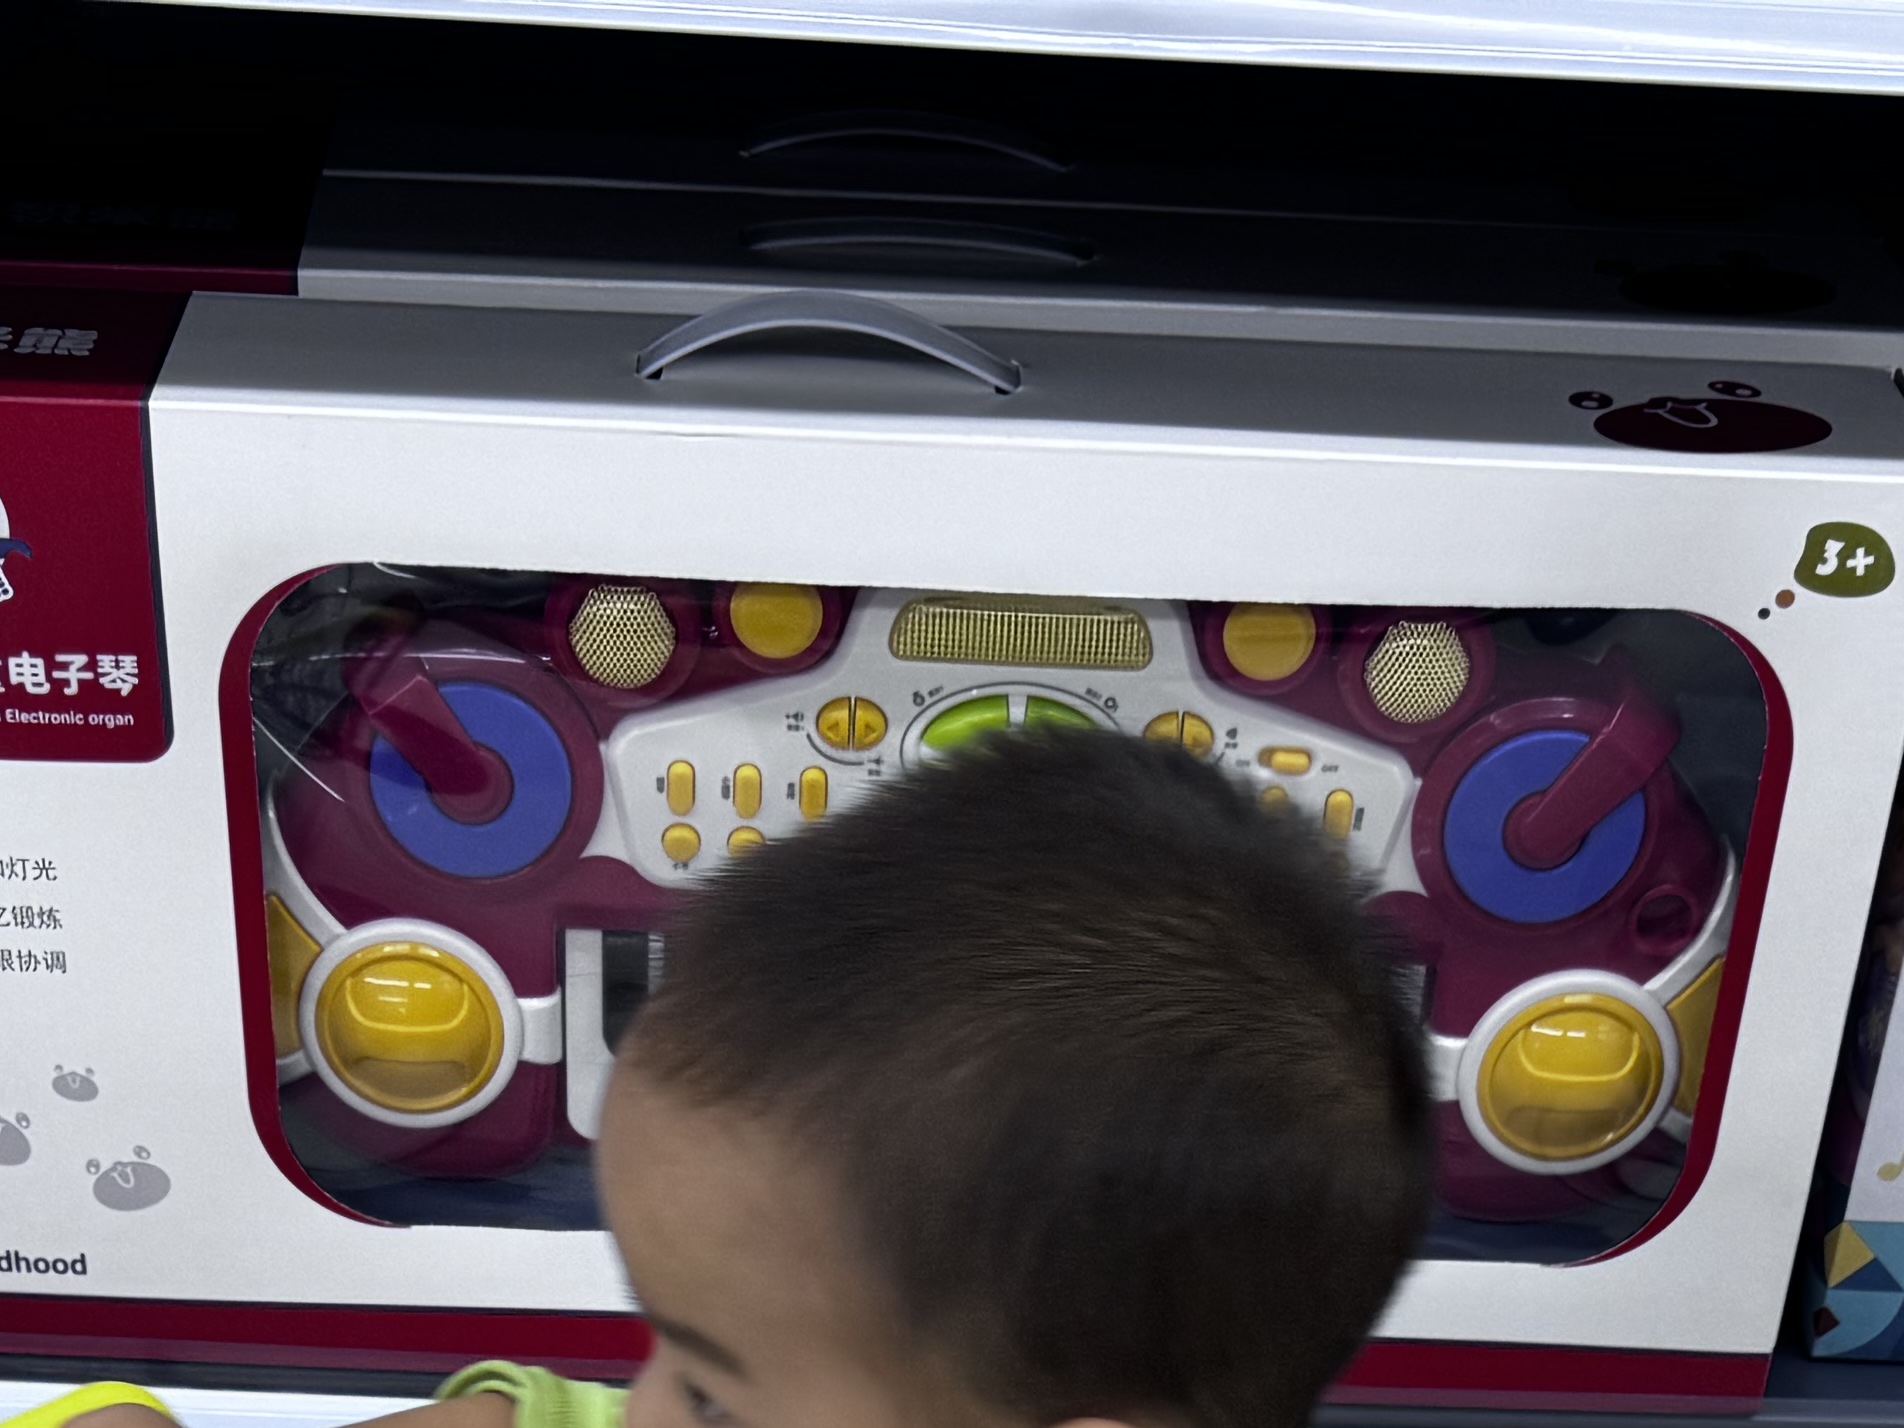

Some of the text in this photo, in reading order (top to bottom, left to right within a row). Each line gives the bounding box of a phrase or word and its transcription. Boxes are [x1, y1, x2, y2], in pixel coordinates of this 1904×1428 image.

[1816, 539, 1875, 577] 3+
[5, 708, 85, 727] Electronic
[87, 711, 135, 729] organ
